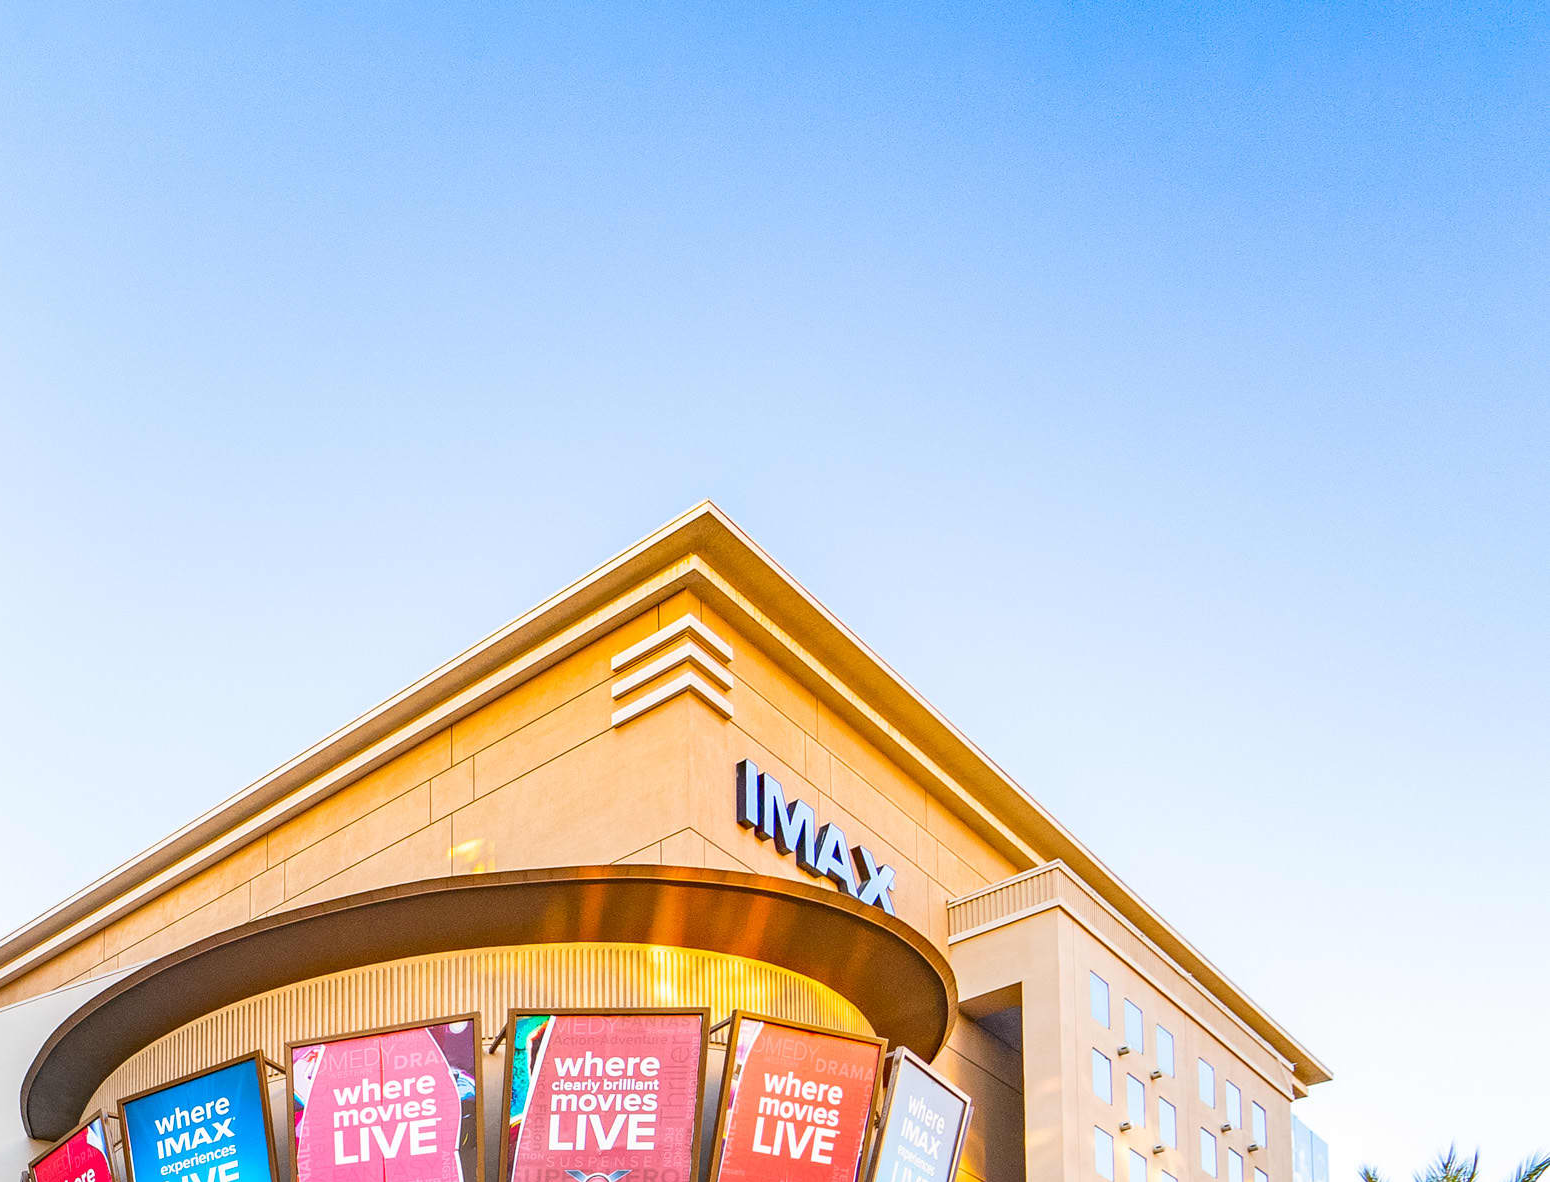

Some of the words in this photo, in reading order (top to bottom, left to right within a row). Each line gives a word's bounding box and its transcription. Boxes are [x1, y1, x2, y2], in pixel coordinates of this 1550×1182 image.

[736, 758, 896, 917] IMAX
[554, 1051, 660, 1077] where
[333, 1074, 436, 1106] where
[551, 1079, 600, 1093] clearly
[603, 1078, 660, 1091] brilliant
[764, 1071, 843, 1105] where
[154, 1096, 230, 1136] where
[333, 1098, 437, 1128] movies
[551, 1093, 658, 1112] movies
[758, 1096, 839, 1127] movies
[908, 1095, 945, 1135] where
[156, 1117, 235, 1159] IMAX
[334, 1118, 438, 1165] LIVE
[549, 1114, 656, 1150] LIVE
[752, 1116, 838, 1165] LIVE
[900, 1117, 941, 1160] IMAX
[160, 1144, 237, 1176] experiences
[546, 1155, 651, 1168] SUSPENSE
[897, 1144, 936, 1176] experiences
